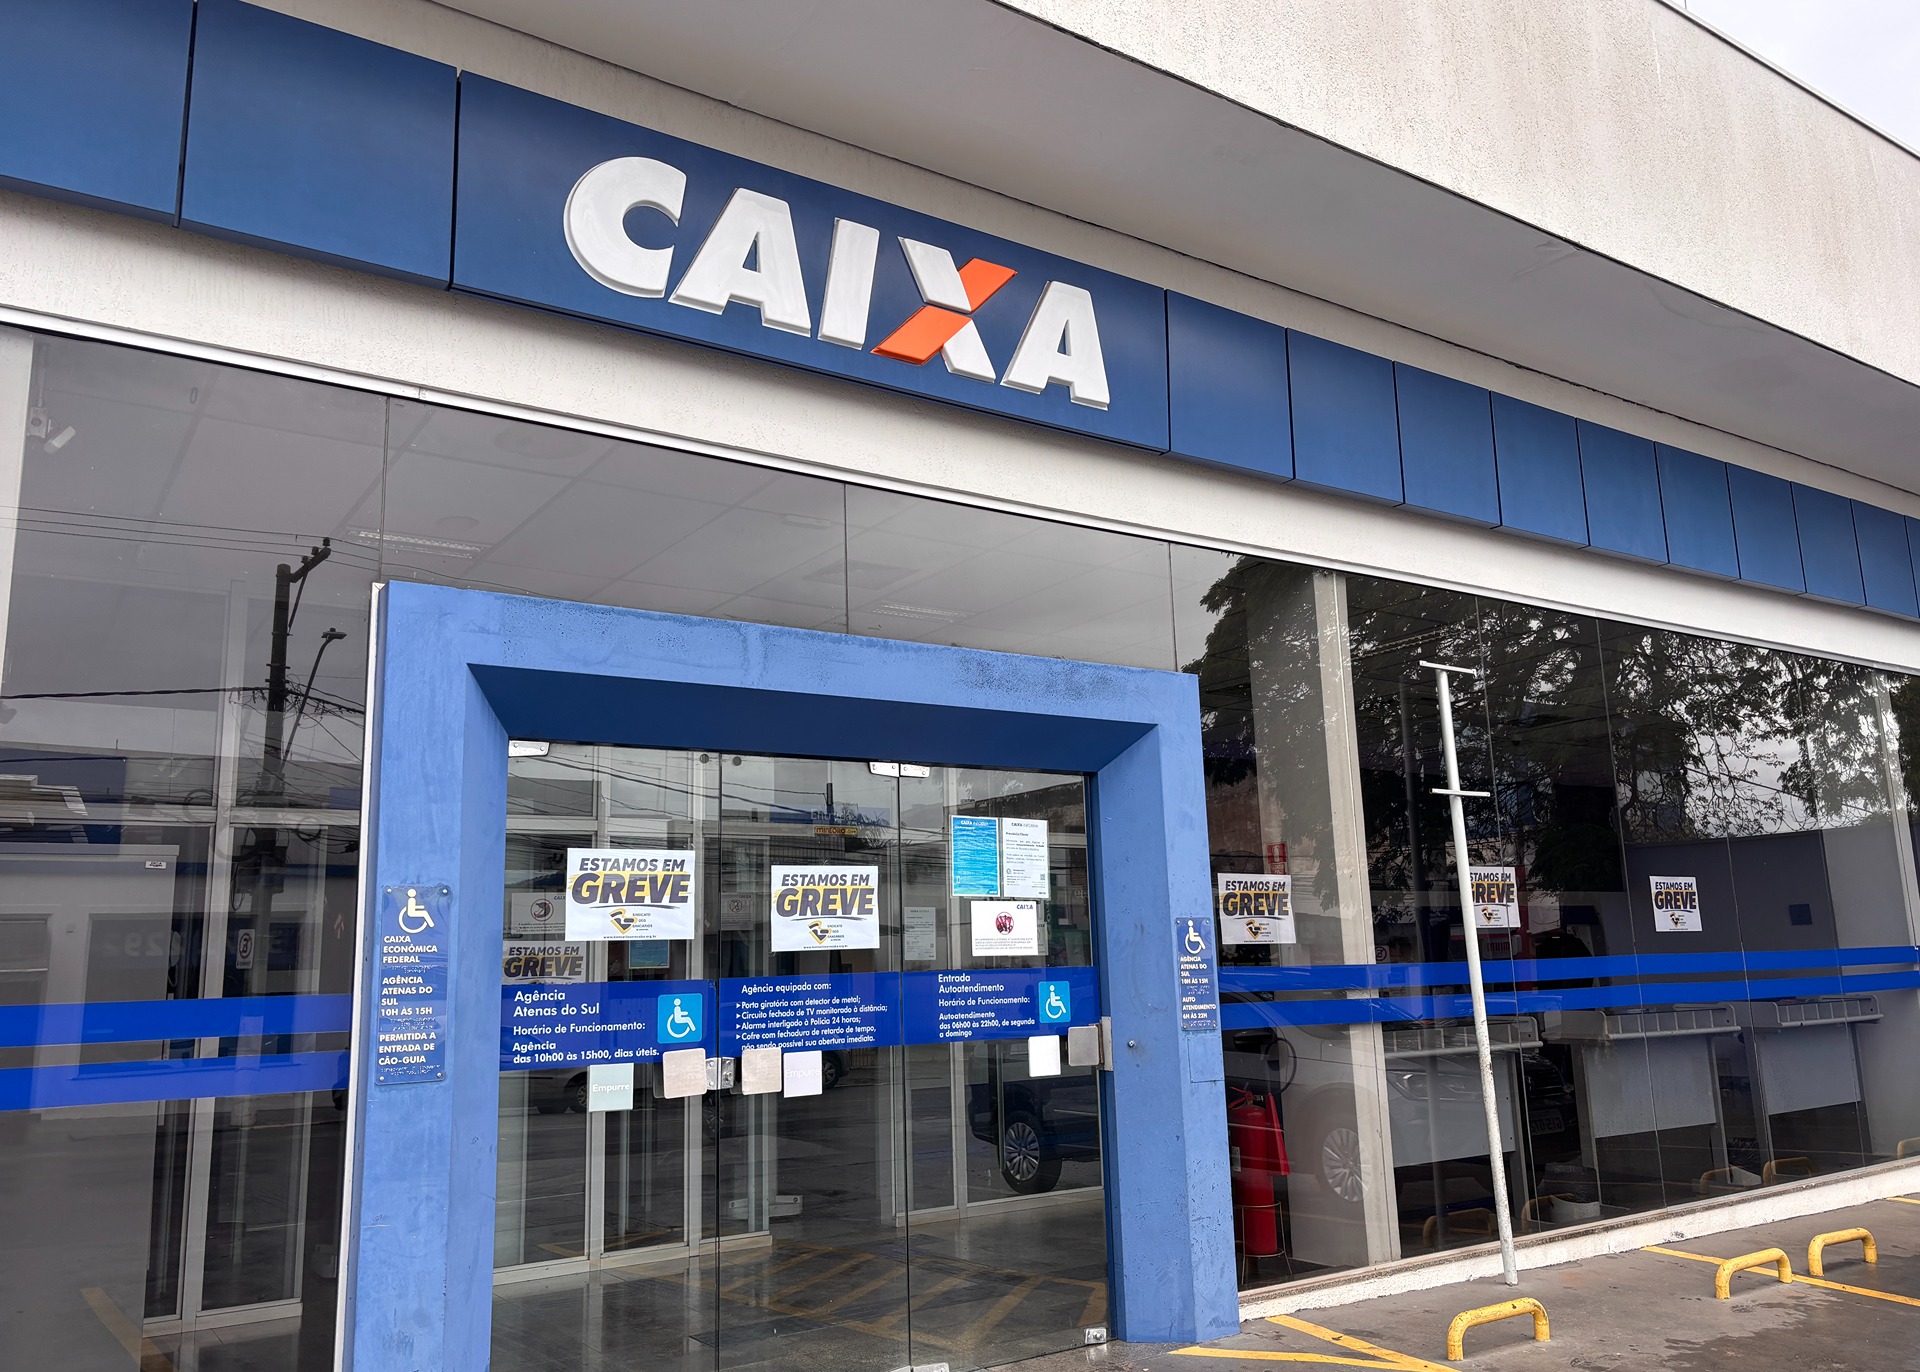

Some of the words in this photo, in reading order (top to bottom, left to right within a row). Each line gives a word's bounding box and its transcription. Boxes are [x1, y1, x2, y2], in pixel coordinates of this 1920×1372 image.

[563, 156, 1110, 411] CAIXA
[579, 857, 658, 872] ESTAMOS
[662, 859, 685, 872] EM
[782, 874, 847, 886] ESTAMOS
[851, 874, 870, 885] EM
[1470, 873, 1499, 881] STAMOS
[1501, 873, 1511, 881] EM
[572, 873, 691, 904] GREVE
[1225, 881, 1270, 891] ESTAMOS
[1272, 882, 1285, 891] EM
[1655, 882, 1682, 890] ESTAMOS
[776, 888, 874, 917] GREVE
[1223, 892, 1289, 916] GREVE
[1655, 891, 1696, 910] GREVE
[384, 935, 411, 943] CAIXA
[383, 943, 437, 953] ECONÔMICA
[508, 947, 561, 956] ESTAMOS
[563, 947, 579, 955] EM
[504, 957, 583, 978] GREVE
[383, 975, 423, 985] AGÊNCIA
[938, 973, 970, 983] Entrada
[382, 987, 417, 995] ATENAS
[419, 986, 433, 994] DO
[742, 984, 773, 995] Agência
[776, 982, 811, 993] equipada
[939, 984, 1004, 993] Autoatendimento
[381, 998, 398, 1006] SUL
[514, 991, 565, 1003] Agência
[939, 998, 965, 1006] Horário
[967, 998, 976, 1006] de
[978, 997, 1030, 1005] Funcionamento:
[761, 1000, 788, 1010] giratória
[842, 996, 860, 1004] metal;
[381, 1008, 399, 1016] 10H
[401, 1006, 414, 1015] ÀS
[513, 1005, 558, 1017] Atenas
[561, 1004, 577, 1015] do
[580, 1003, 600, 1014] Sul
[742, 1011, 767, 1019] Circuito
[769, 1009, 794, 1018] fechado
[816, 1006, 851, 1014] monitorado
[859, 1004, 887, 1012] distância;
[939, 1012, 995, 1020] Autoatendimento
[741, 1022, 766, 1030] Alarme
[768, 1020, 802, 1029] interligado
[804, 1018, 808, 1026] à
[842, 1016, 861, 1024] horas;
[952, 1021, 971, 1029] 06h00
[973, 1020, 979, 1028] às
[1011, 1018, 1035, 1026] segunda
[513, 1024, 552, 1036] Horário
[555, 1024, 567, 1033] de
[570, 1022, 645, 1033] Funcionamento:
[742, 1032, 760, 1040] Cofre
[778, 1029, 810, 1038] fechadura
[821, 1027, 844, 1035] retardo
[946, 1030, 972, 1038] domingo
[379, 1033, 427, 1042] PERMITIDA
[756, 1041, 777, 1049] sendo
[818, 1037, 845, 1045] abertura
[847, 1035, 875, 1043] imediata.
[379, 1044, 422, 1053] ENTRADA
[513, 1041, 556, 1052] Agência
[379, 1055, 426, 1065] CÃO-GUIA
[513, 1054, 532, 1064] das
[534, 1052, 564, 1063] 10h00
[566, 1051, 578, 1061] às
[580, 1049, 612, 1061] 15h00,
[614, 1048, 633, 1058] dias
[636, 1046, 659, 1057] úteis.
[786, 1068, 820, 1078] Empurre
[592, 1082, 630, 1093] Empurre
